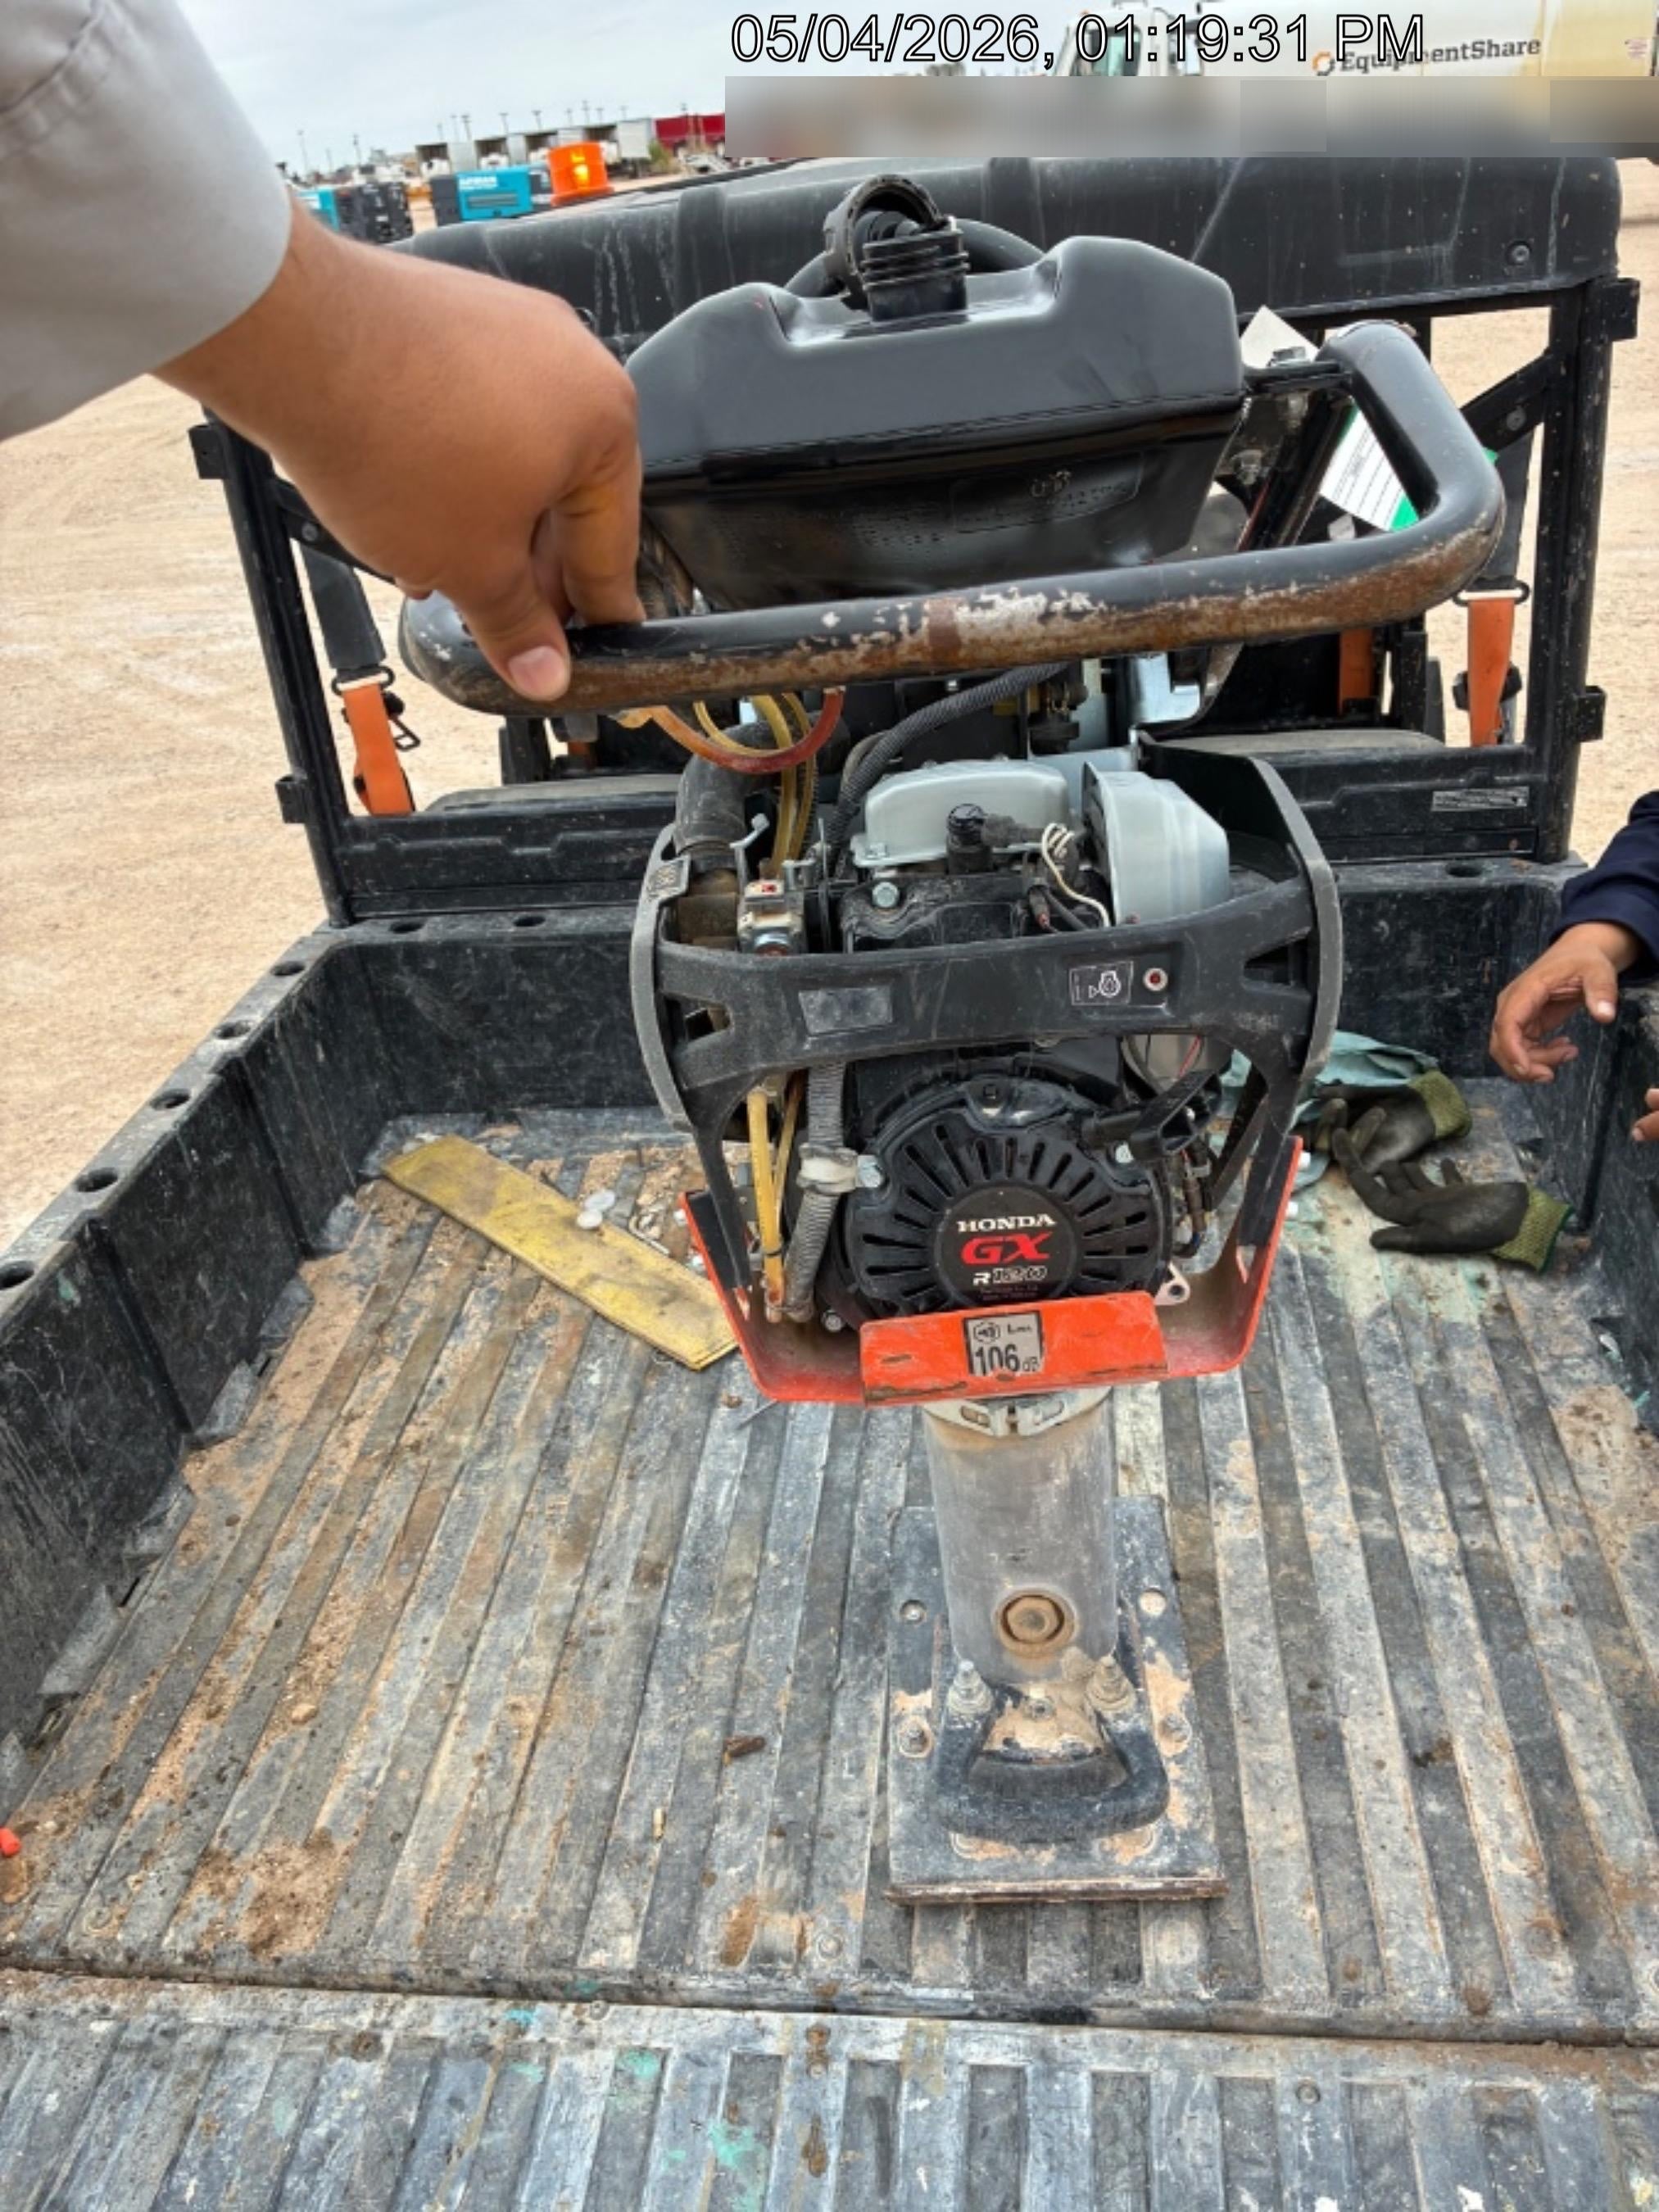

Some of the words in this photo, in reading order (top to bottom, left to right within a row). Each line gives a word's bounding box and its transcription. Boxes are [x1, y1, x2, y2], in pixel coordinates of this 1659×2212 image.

[957, 1213, 1057, 1232] HONDA
[960, 1231, 1053, 1264] GX
[975, 1344, 1021, 1376] 106
